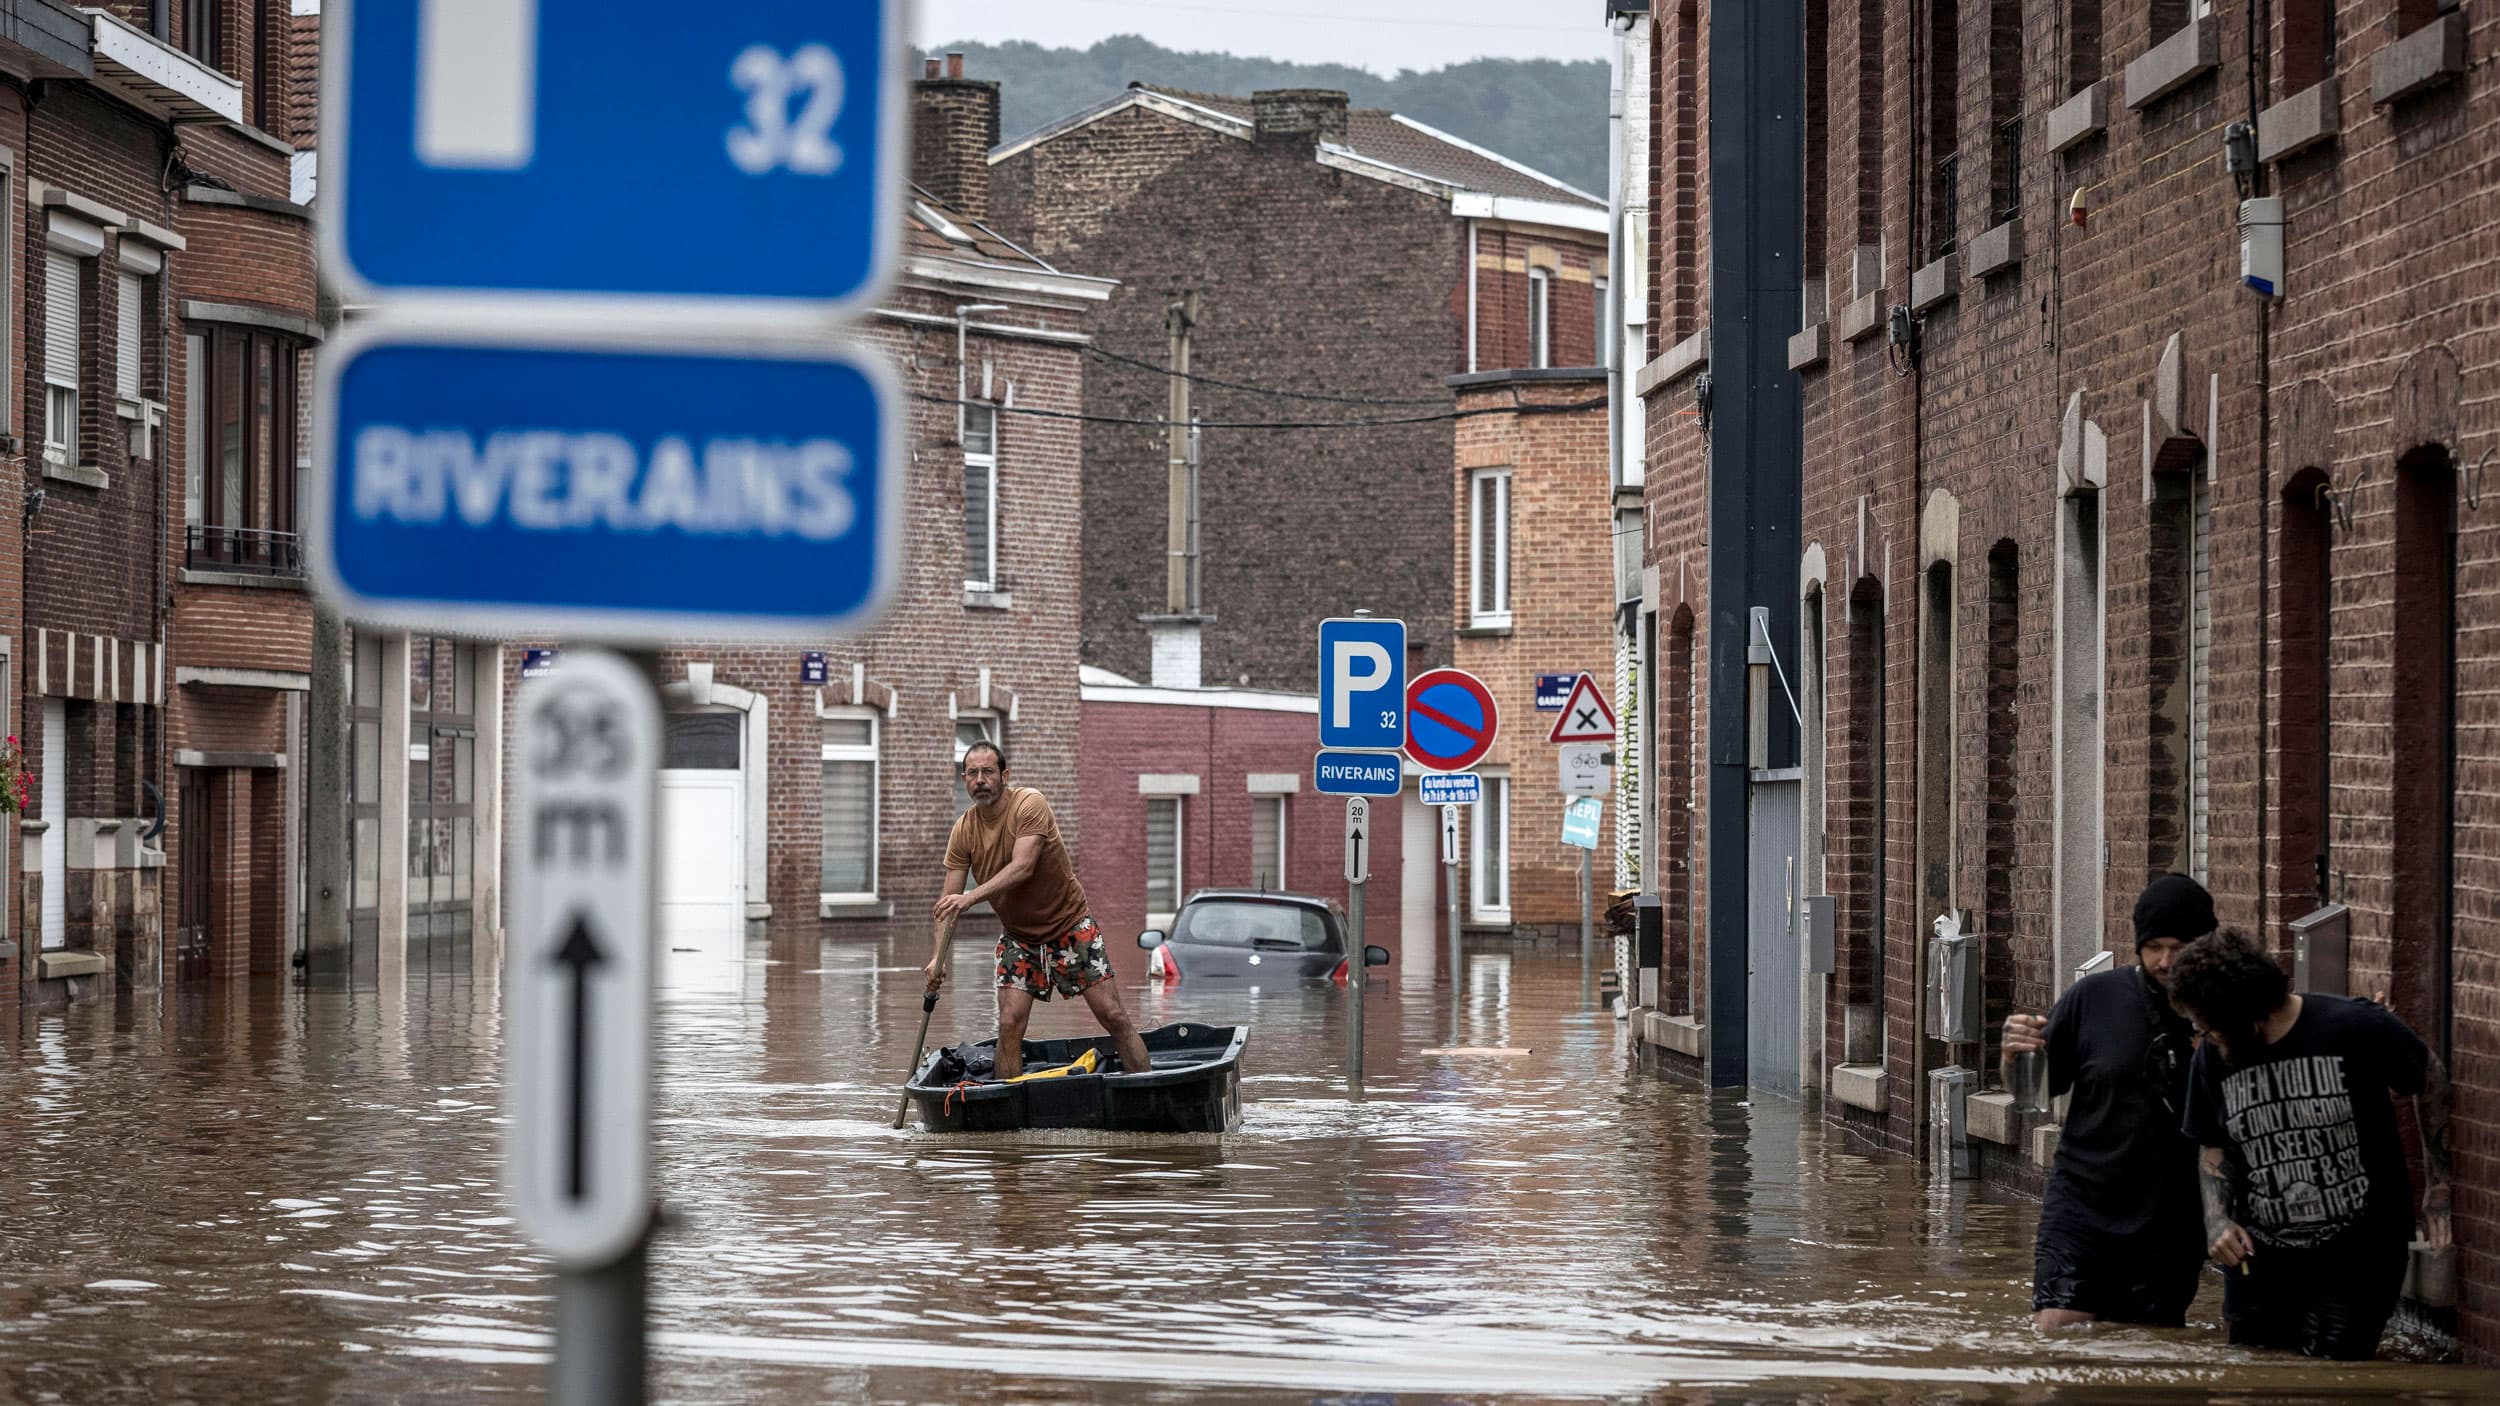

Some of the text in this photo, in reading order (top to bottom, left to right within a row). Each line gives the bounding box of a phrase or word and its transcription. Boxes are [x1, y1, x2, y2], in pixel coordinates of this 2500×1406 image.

[725, 42, 846, 176] 32
[352, 424, 858, 540] RIVERAINS
[1333, 641, 1392, 728] P
[1380, 711, 1397, 729] 32
[1321, 765, 1395, 782] RIVERAINS
[1351, 807, 1363, 816] 20
[532, 800, 628, 867] m
[2221, 1056, 2349, 1118] WHEN YOU DIE
[2246, 1101, 2284, 1138] ONLY
[2285, 1095, 2354, 1129] KINGDOM
[2274, 1129, 2307, 1161] SEE
[2305, 1128, 2325, 1158] IS
[2322, 1121, 2358, 1153] TWO
[2319, 1155, 2340, 1186] &
[2337, 1145, 2366, 1181] SIX
